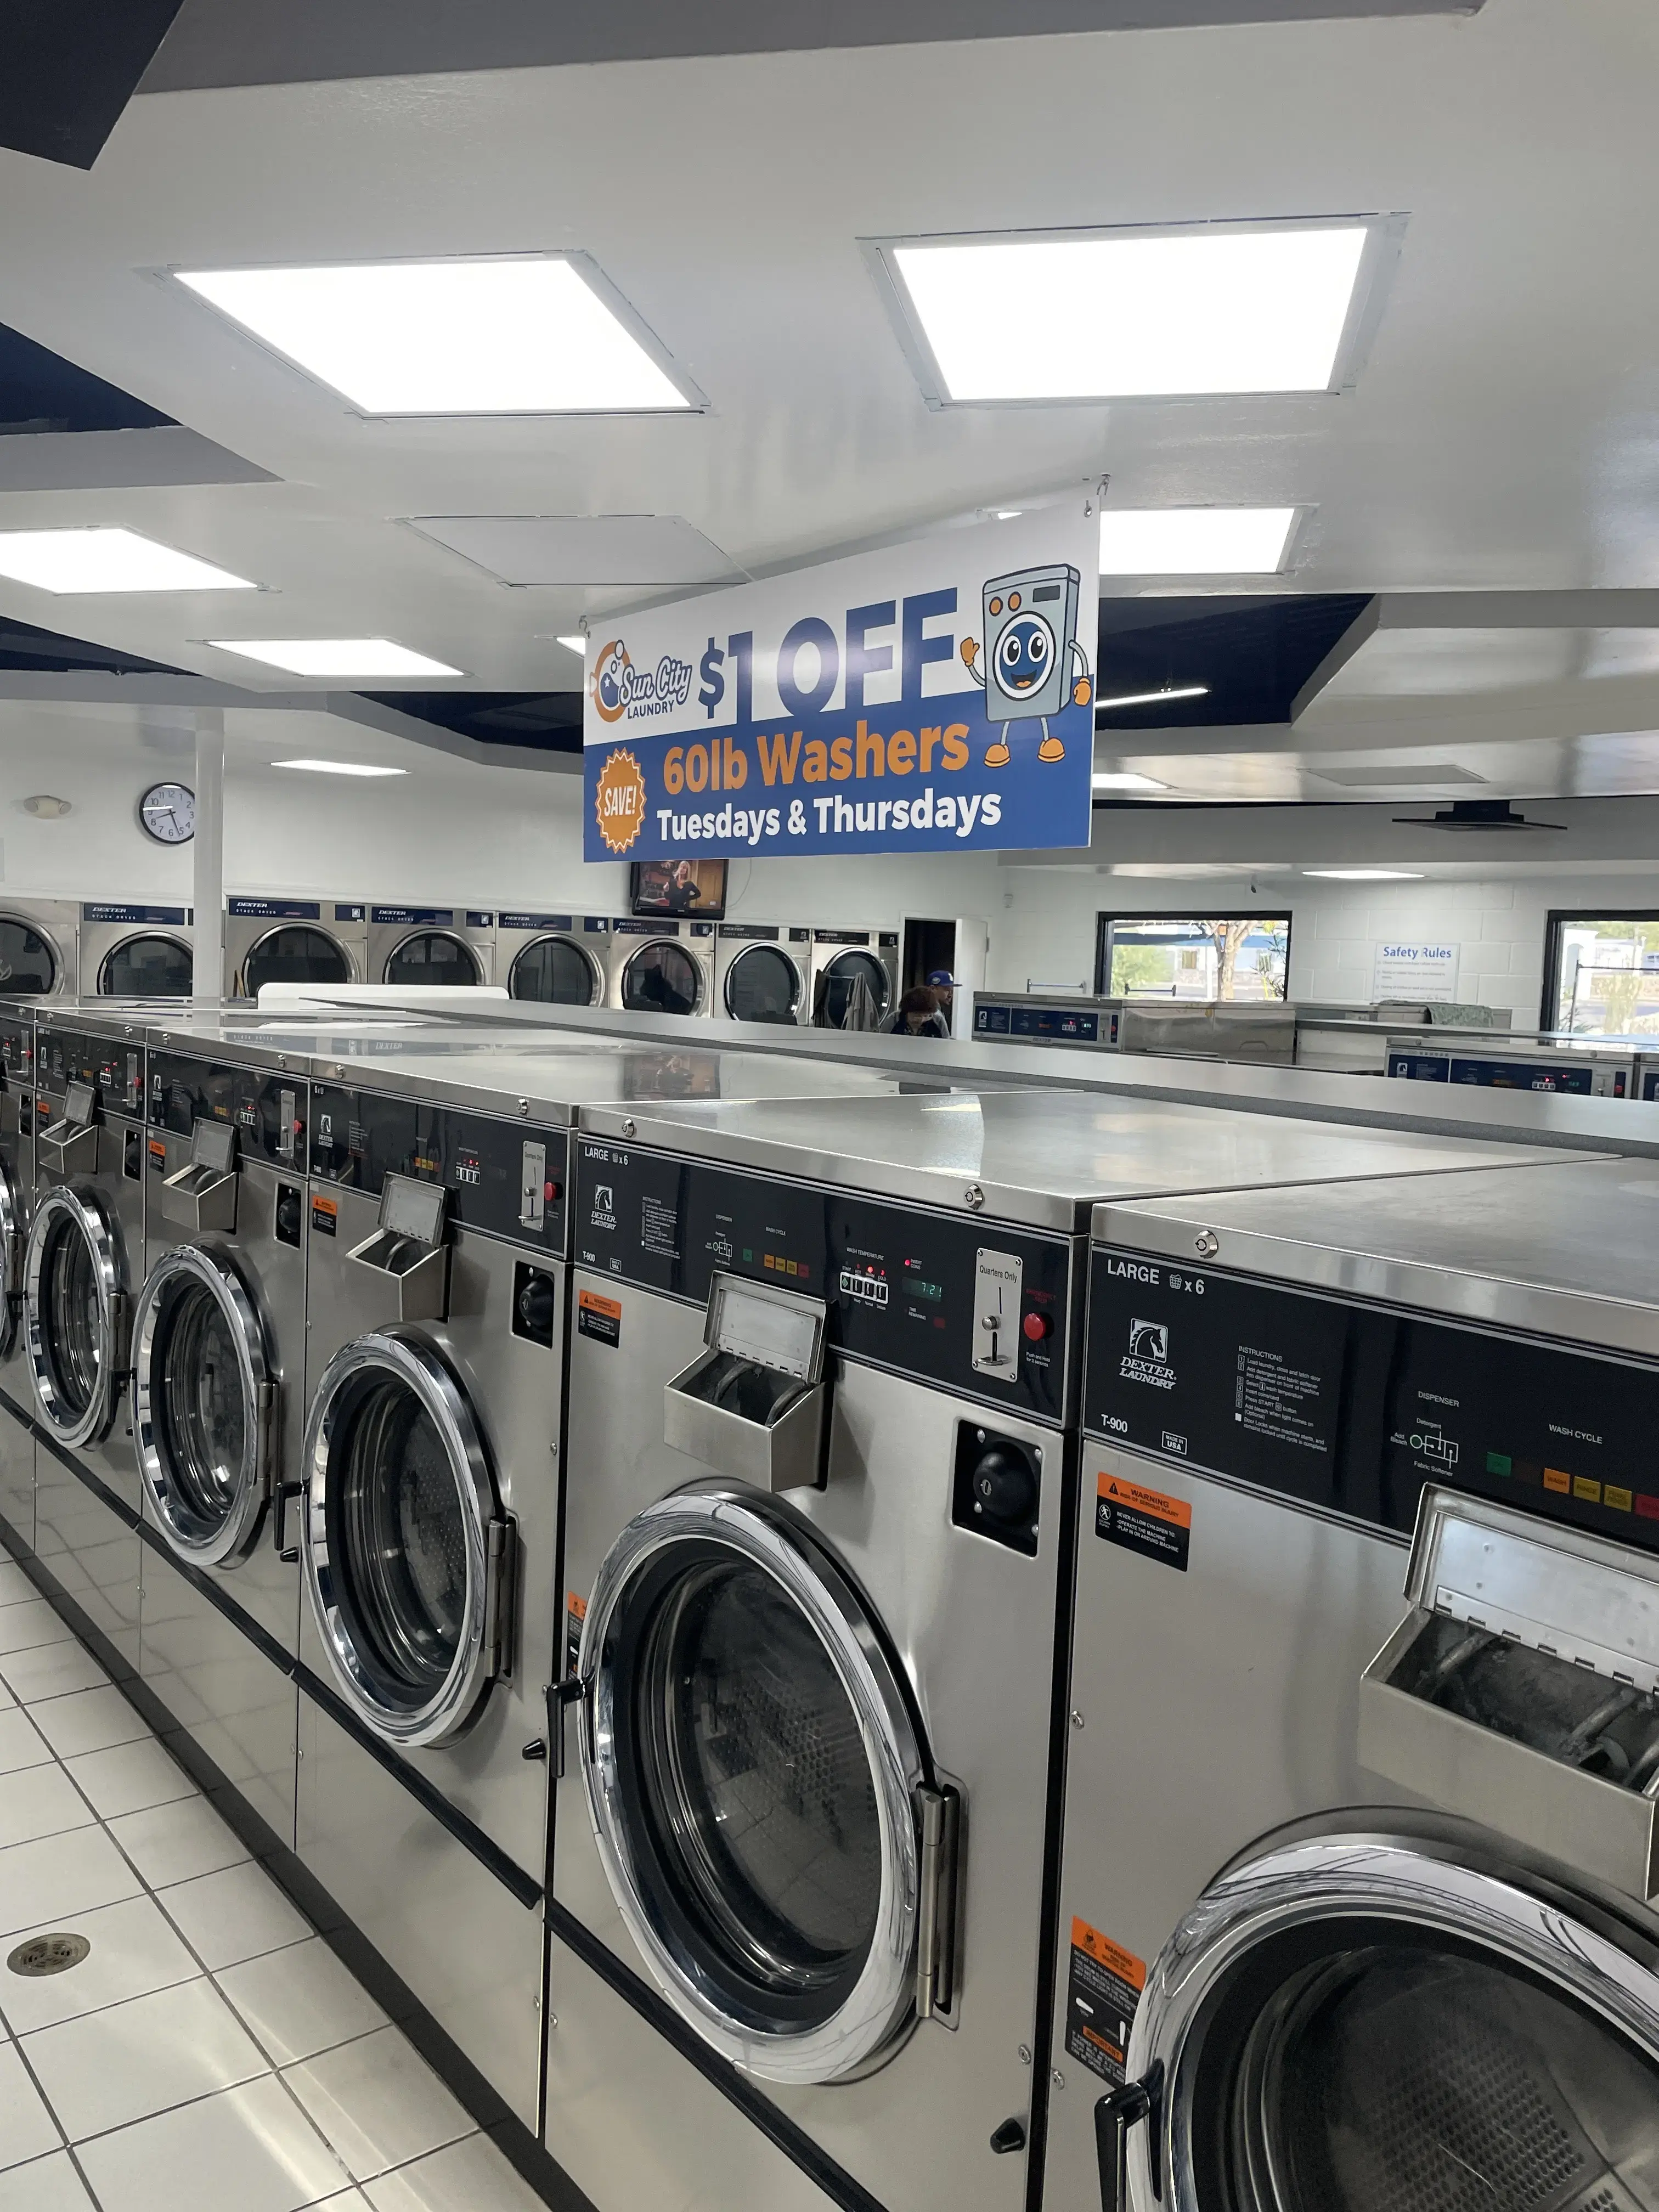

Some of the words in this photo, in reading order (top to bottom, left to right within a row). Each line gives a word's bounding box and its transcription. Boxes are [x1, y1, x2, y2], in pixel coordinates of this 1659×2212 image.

[698, 631, 752, 723] $1
[777, 587, 957, 716] OFF
[620, 664, 654, 707] Sun
[656, 656, 692, 705] City
[628, 700, 674, 719] LAUNDRY
[664, 737, 747, 794] 60lb
[757, 720, 969, 786] Washers
[605, 785, 636, 816] SAVE!
[657, 803, 780, 845] Tuesdays
[788, 799, 806, 835] &
[814, 788, 1001, 837] Thursdays
[1384, 947, 1418, 960] Safety
[1421, 947, 1451, 958] Rules
[585, 1146, 608, 1161] LARGE
[624, 1155, 628, 1165] 6
[591, 1211, 616, 1223] DEXTER
[591, 1218, 616, 1230] LAUNDRY
[857, 1249, 884, 1261] TEMPERATURE
[980, 1265, 1003, 1278] Quarters
[1005, 1271, 1017, 1283] Only
[1108, 1259, 1159, 1285] LARGE
[1184, 1280, 1192, 1292] x
[1195, 1279, 1204, 1294] 6
[1239, 1346, 1283, 1362] INSTRUCTIONS
[1120, 1356, 1175, 1380] DEXTER
[1119, 1368, 1176, 1390] LAUNDRY
[1258, 1399, 1274, 1407] START
[1418, 1391, 1459, 1407] DISPENSER
[1101, 1414, 1128, 1432] T-900
[1417, 1418, 1441, 1430] Detergent
[1549, 1424, 1572, 1436] WASH
[1575, 1431, 1602, 1444] CYCLE
[1167, 1441, 1181, 1451] USA
[1414, 1460, 1430, 1470] Fabric
[1131, 1488, 1169, 1508] WARNING
[1117, 1511, 1131, 1521] NEVER
[1131, 1517, 1146, 1526] ALLOW
[1147, 1522, 1168, 1534] CHILDREN
[1160, 1541, 1178, 1553] MACHINE
